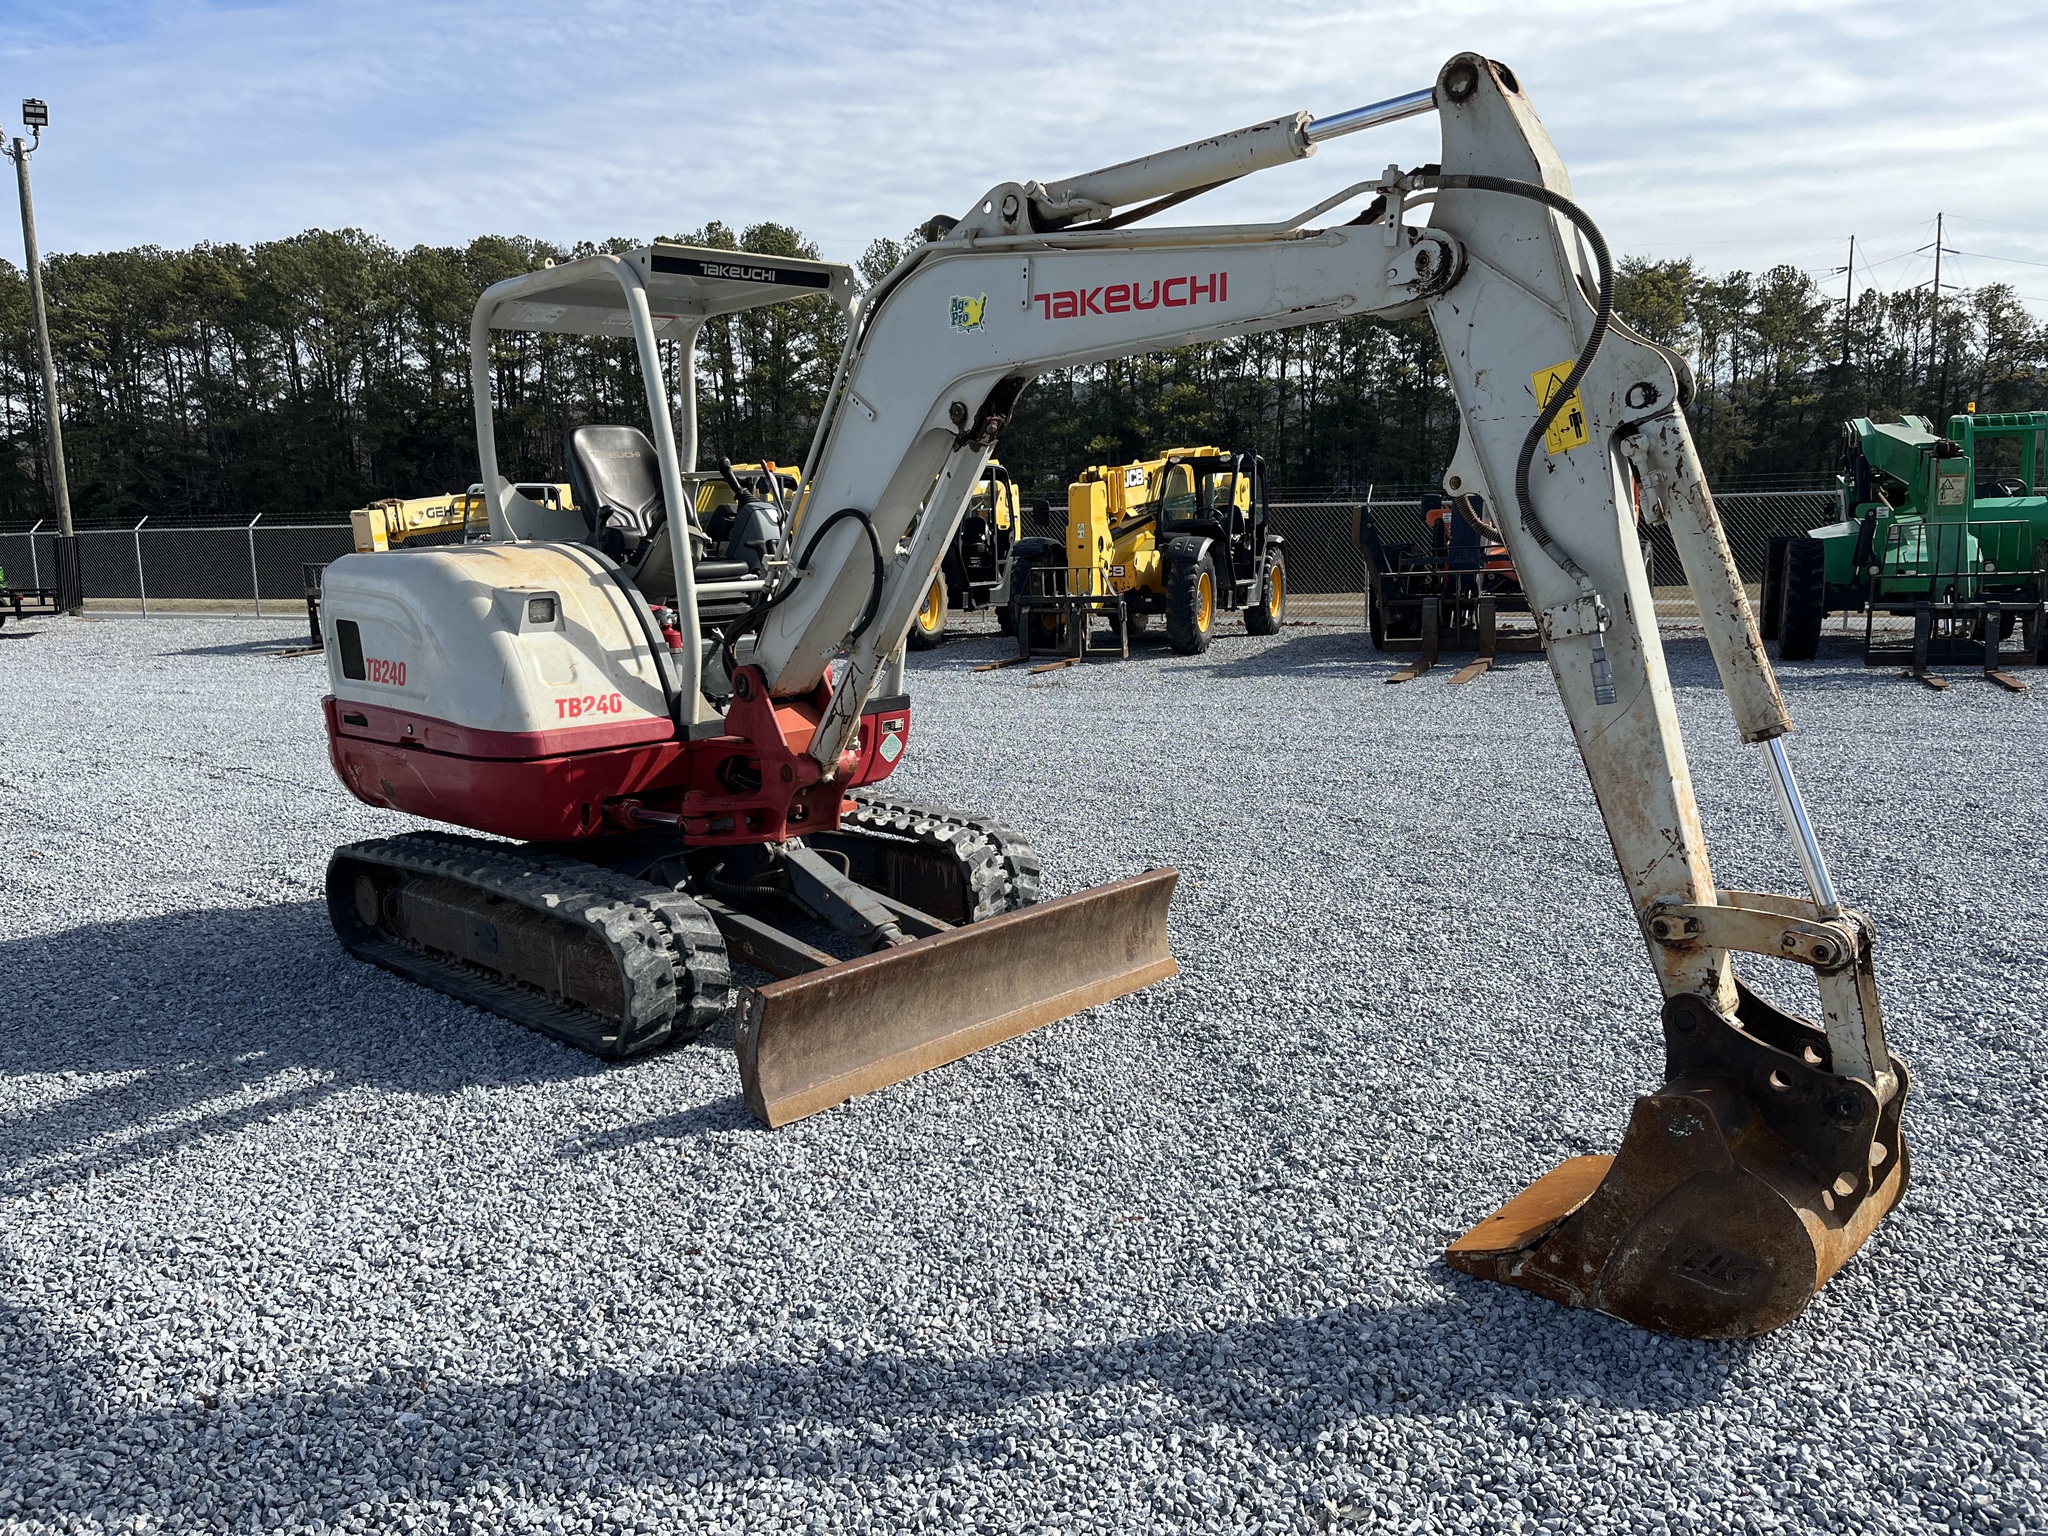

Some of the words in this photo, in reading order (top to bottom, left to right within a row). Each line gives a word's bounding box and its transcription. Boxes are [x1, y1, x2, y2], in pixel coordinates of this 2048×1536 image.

[951, 311, 969, 325] Pro
[1124, 468, 1144, 488] JCB
[425, 504, 461, 519] GEHL
[365, 657, 407, 687] TB240
[554, 692, 623, 719] TB240
